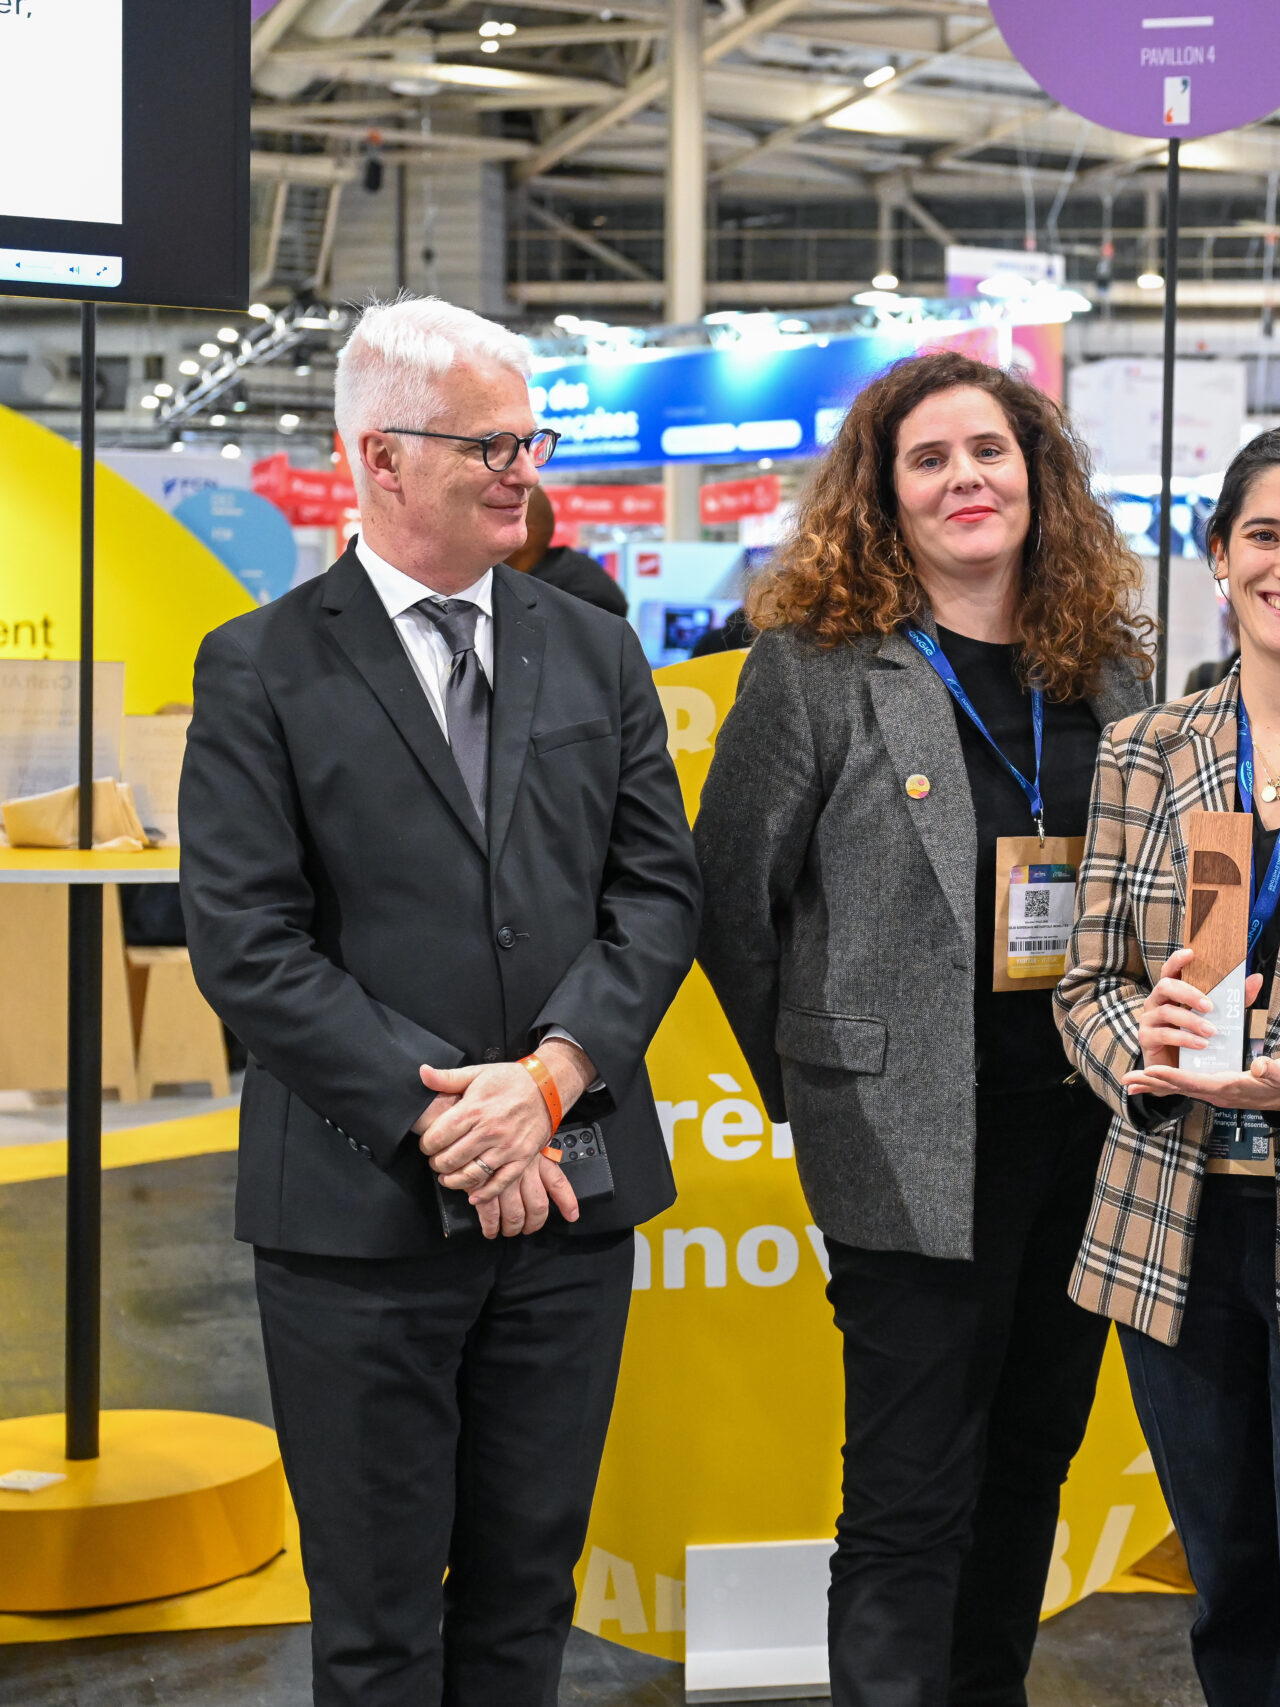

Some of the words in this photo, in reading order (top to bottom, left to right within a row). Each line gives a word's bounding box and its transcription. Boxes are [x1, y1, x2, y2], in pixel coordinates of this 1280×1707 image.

[1140, 46, 1204, 67] PAVILLON
[1206, 44, 1216, 64] 4
[1226, 988, 1240, 1003] 20
[1226, 1004, 1240, 1018] 25
